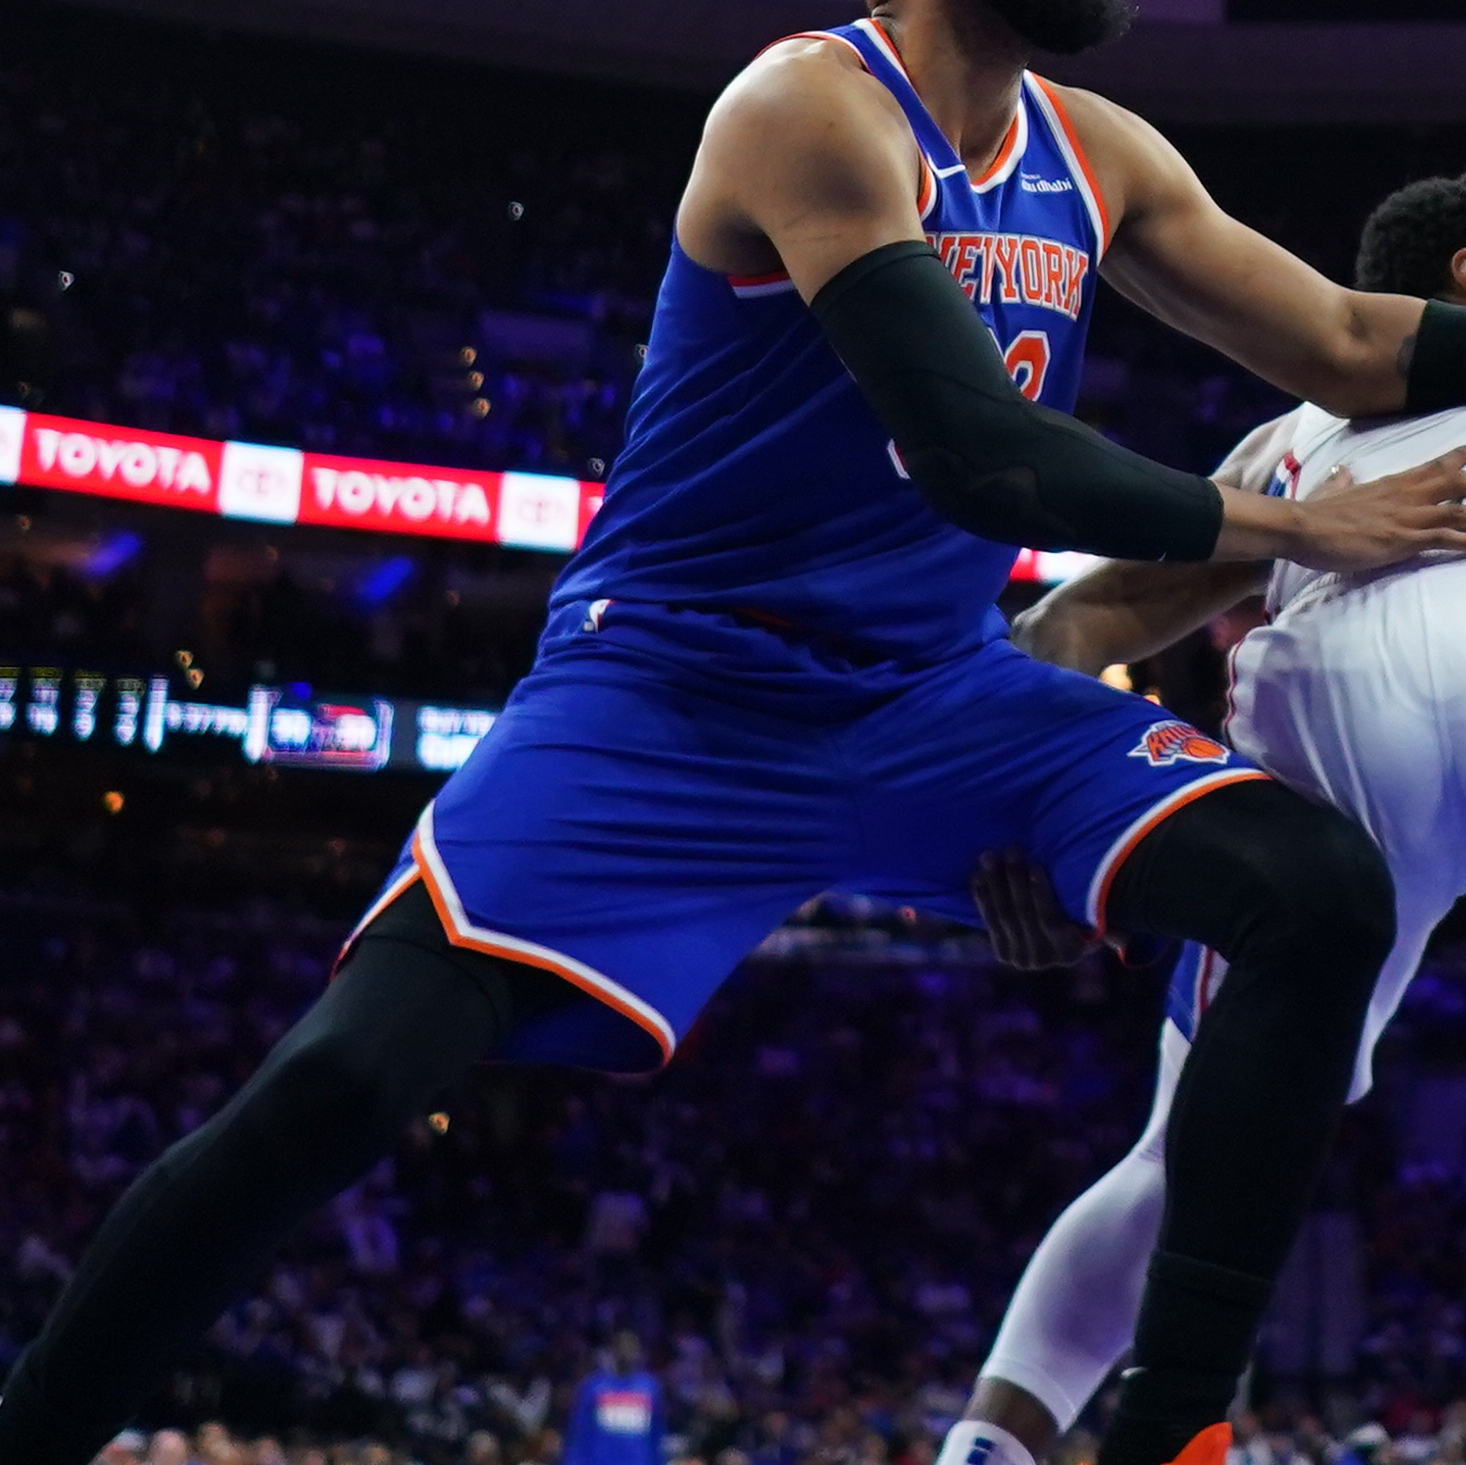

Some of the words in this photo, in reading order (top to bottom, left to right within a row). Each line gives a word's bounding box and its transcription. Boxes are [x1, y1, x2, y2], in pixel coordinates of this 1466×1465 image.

[994, 234, 1090, 322] YORK
[34, 425, 212, 496] TOYOTA
[312, 465, 491, 526] TOYOTA
